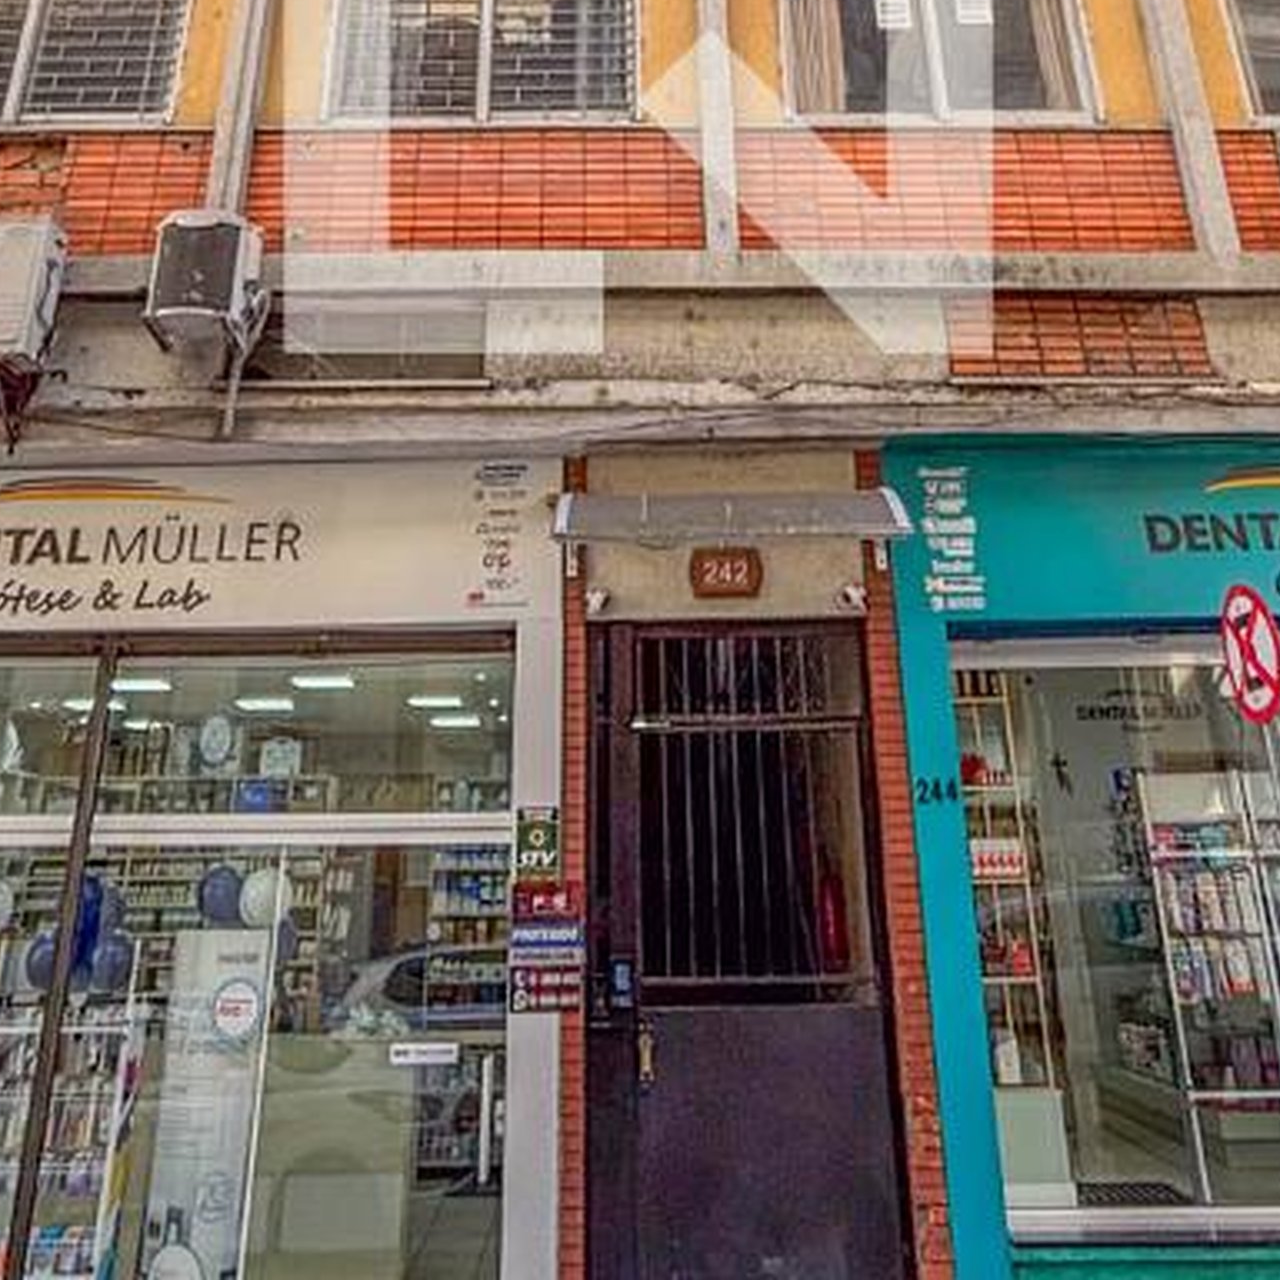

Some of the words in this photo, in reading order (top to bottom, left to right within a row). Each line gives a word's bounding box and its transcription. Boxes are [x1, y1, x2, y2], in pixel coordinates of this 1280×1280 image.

[102, 515, 303, 564] MÜLLER
[701, 560, 750, 587] 242
[92, 580, 121, 610] &
[133, 579, 212, 612] Lab
[915, 778, 959, 806] 244
